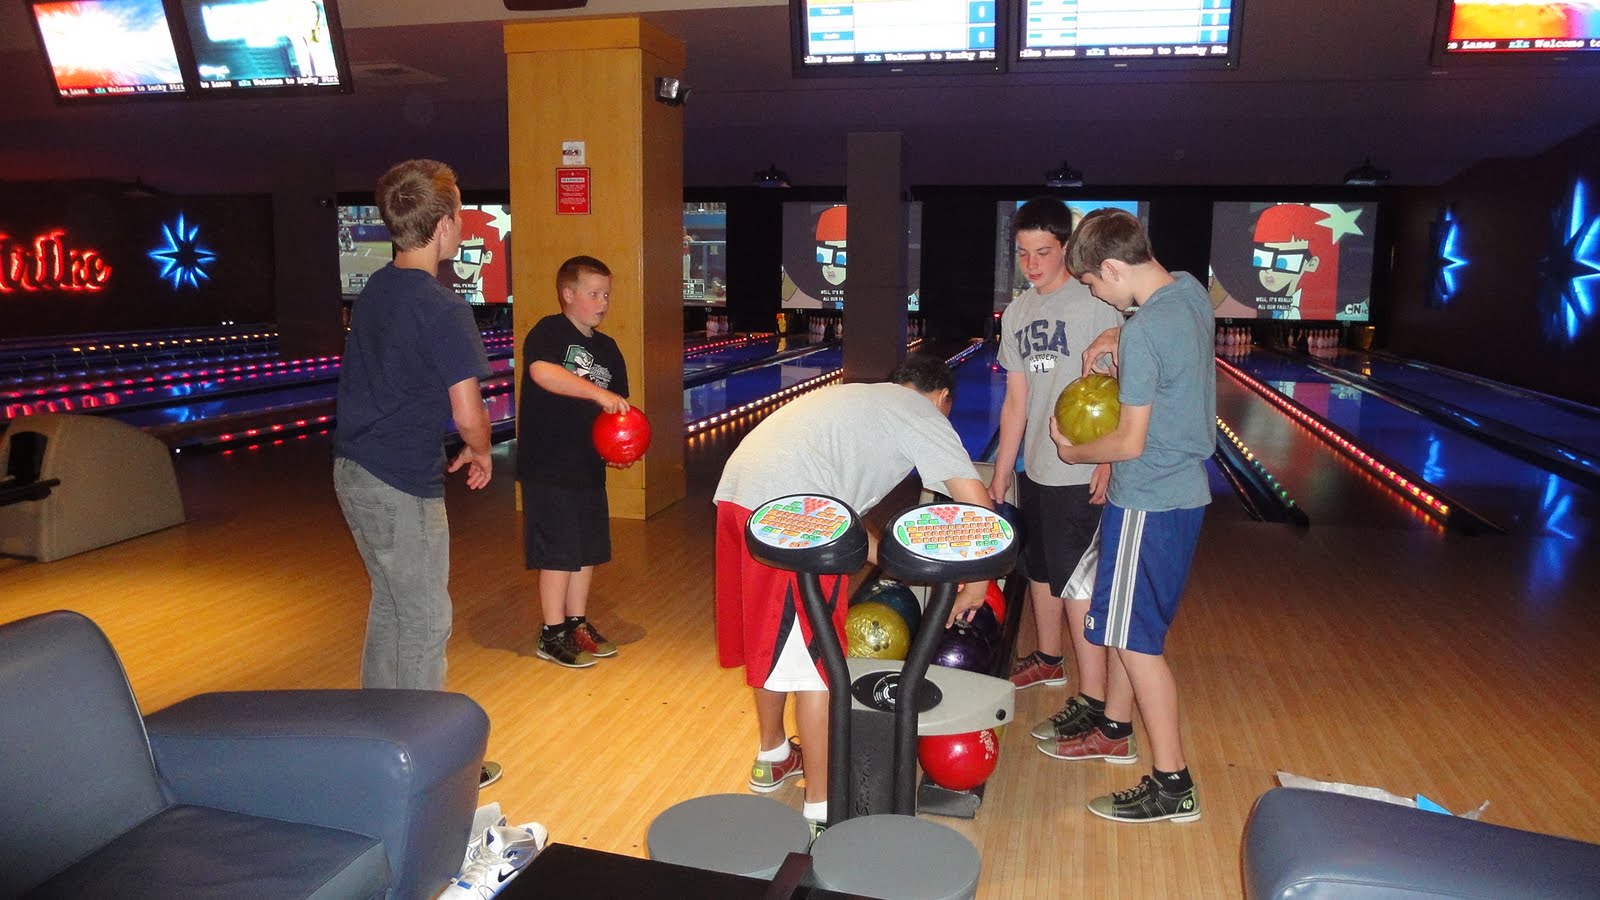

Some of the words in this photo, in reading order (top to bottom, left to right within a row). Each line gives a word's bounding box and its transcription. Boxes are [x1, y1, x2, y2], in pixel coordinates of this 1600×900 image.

[1462, 40, 1496, 48] Lanes
[1534, 39, 1584, 48] Welcome
[1108, 47, 1154, 56] Welcome
[1158, 46, 1172, 54] to
[884, 53, 926, 62] Welcome
[946, 51, 976, 61] Lucky
[252, 78, 284, 86] Welcome
[147, 83, 167, 92] Lucky
[1345, 304, 1360, 314] CN
[1014, 319, 1070, 360] USA
